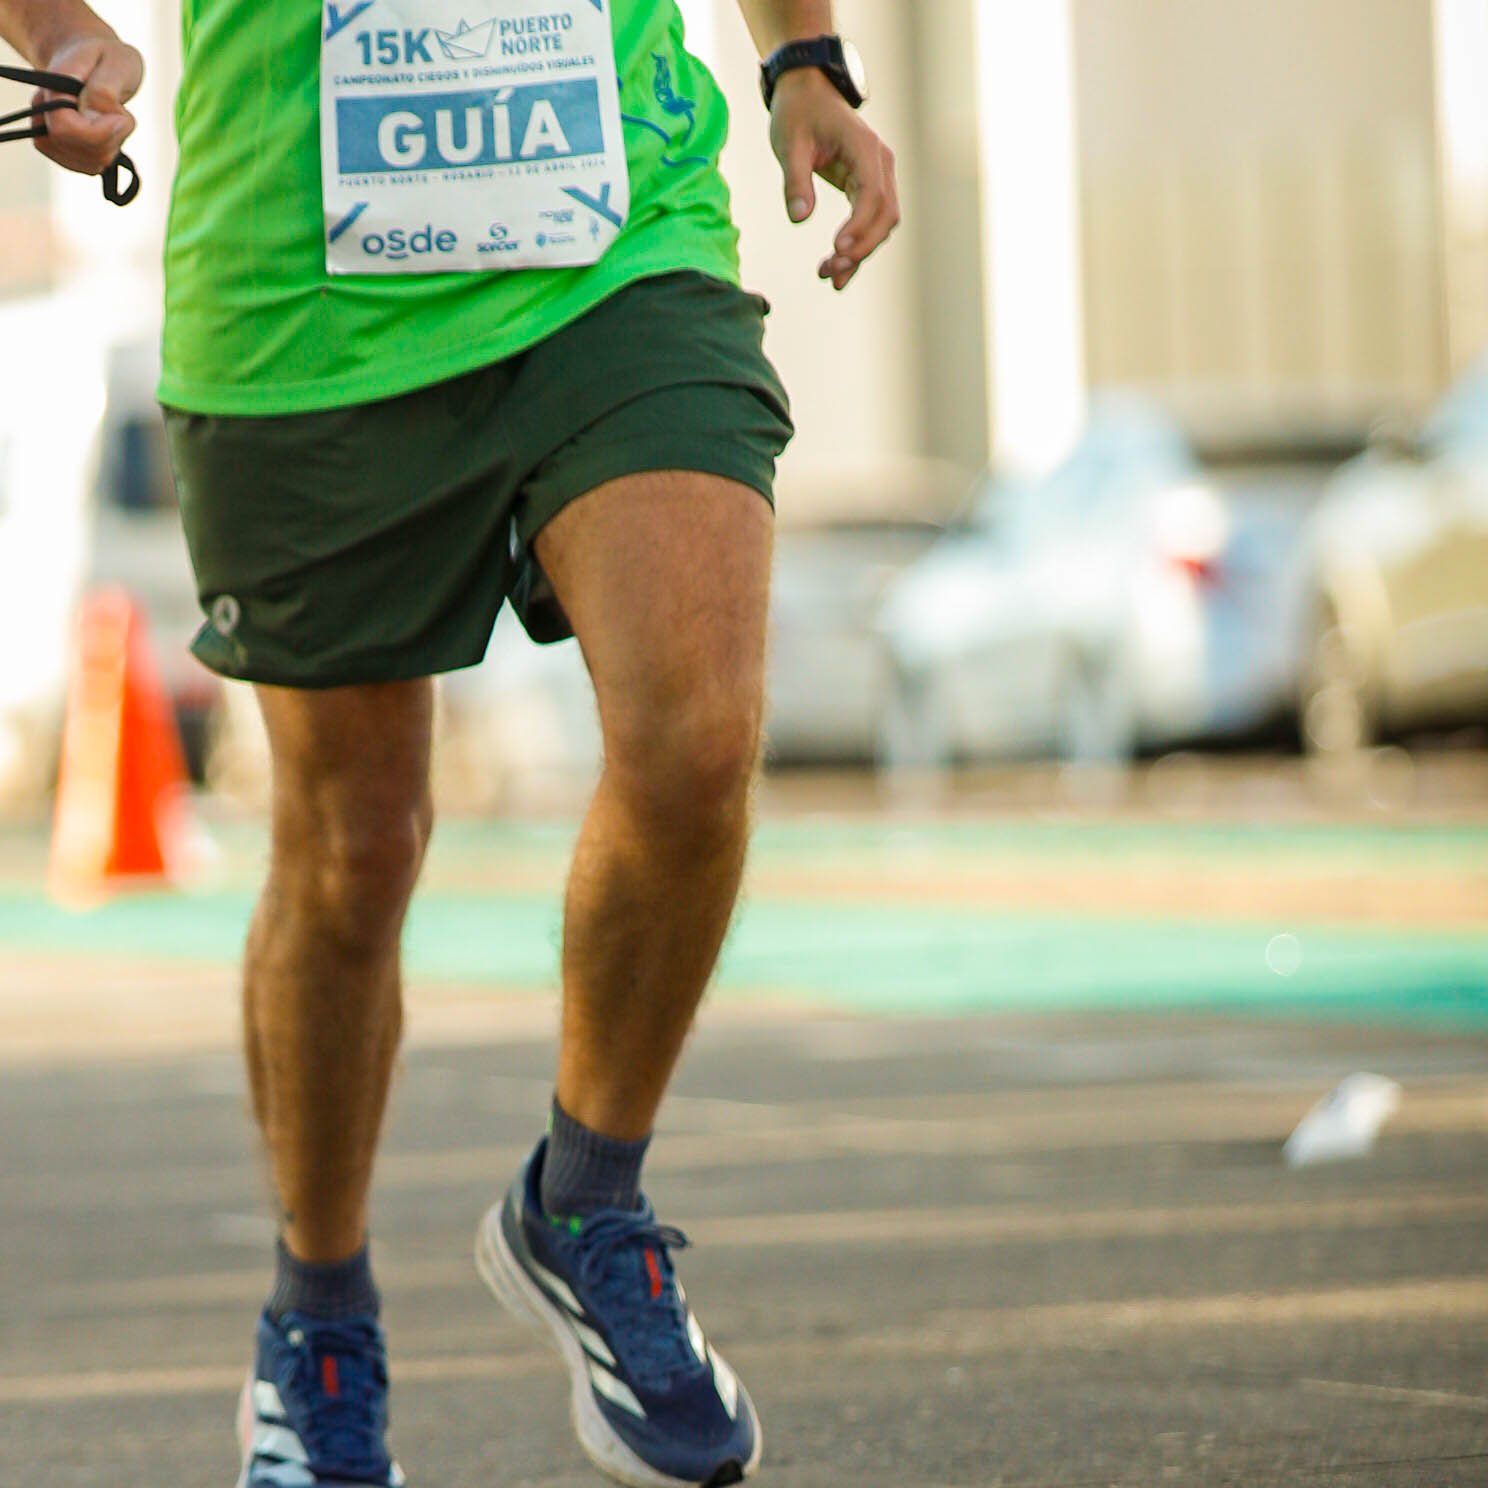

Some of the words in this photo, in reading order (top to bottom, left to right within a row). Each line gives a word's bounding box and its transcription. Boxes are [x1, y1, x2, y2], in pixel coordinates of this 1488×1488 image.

[499, 12, 573, 37] PUERTO
[356, 28, 434, 66] 15K
[500, 33, 563, 56] NORTE
[334, 72, 413, 86] CAMPEONATO
[377, 86, 571, 169] GUÍA
[361, 223, 457, 257] osde
